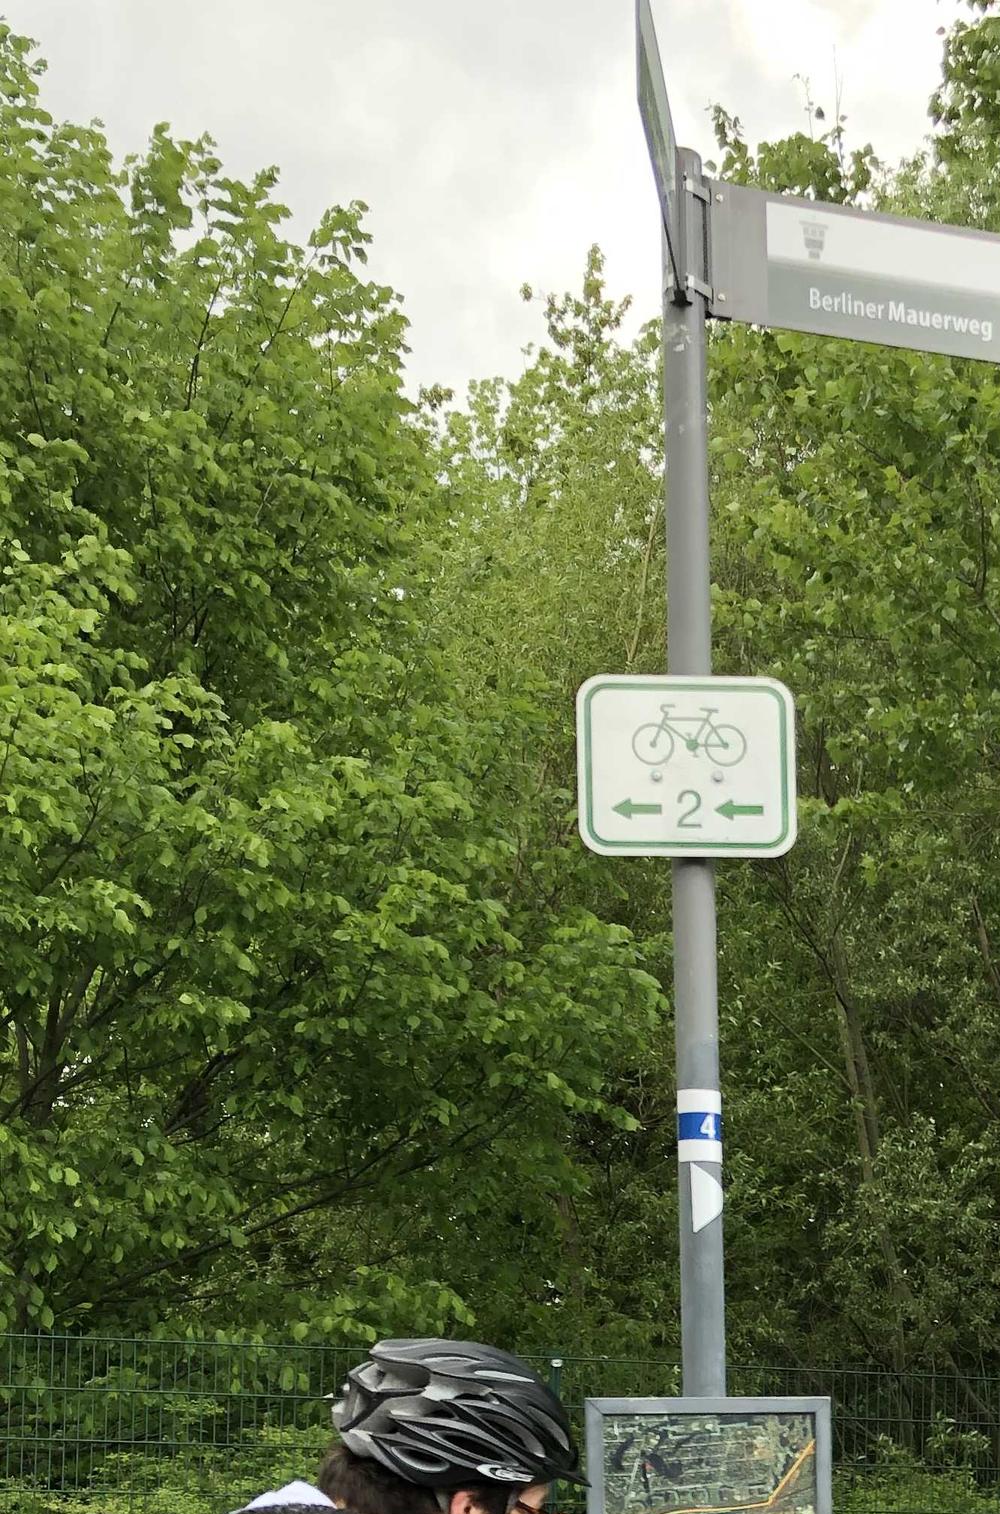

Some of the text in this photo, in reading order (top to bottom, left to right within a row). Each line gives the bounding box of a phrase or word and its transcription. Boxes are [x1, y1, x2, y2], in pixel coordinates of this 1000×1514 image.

[809, 287, 994, 341] Berliner Mauerweg
[676, 789, 703, 828] 2
[700, 1115, 716, 1138] 4
